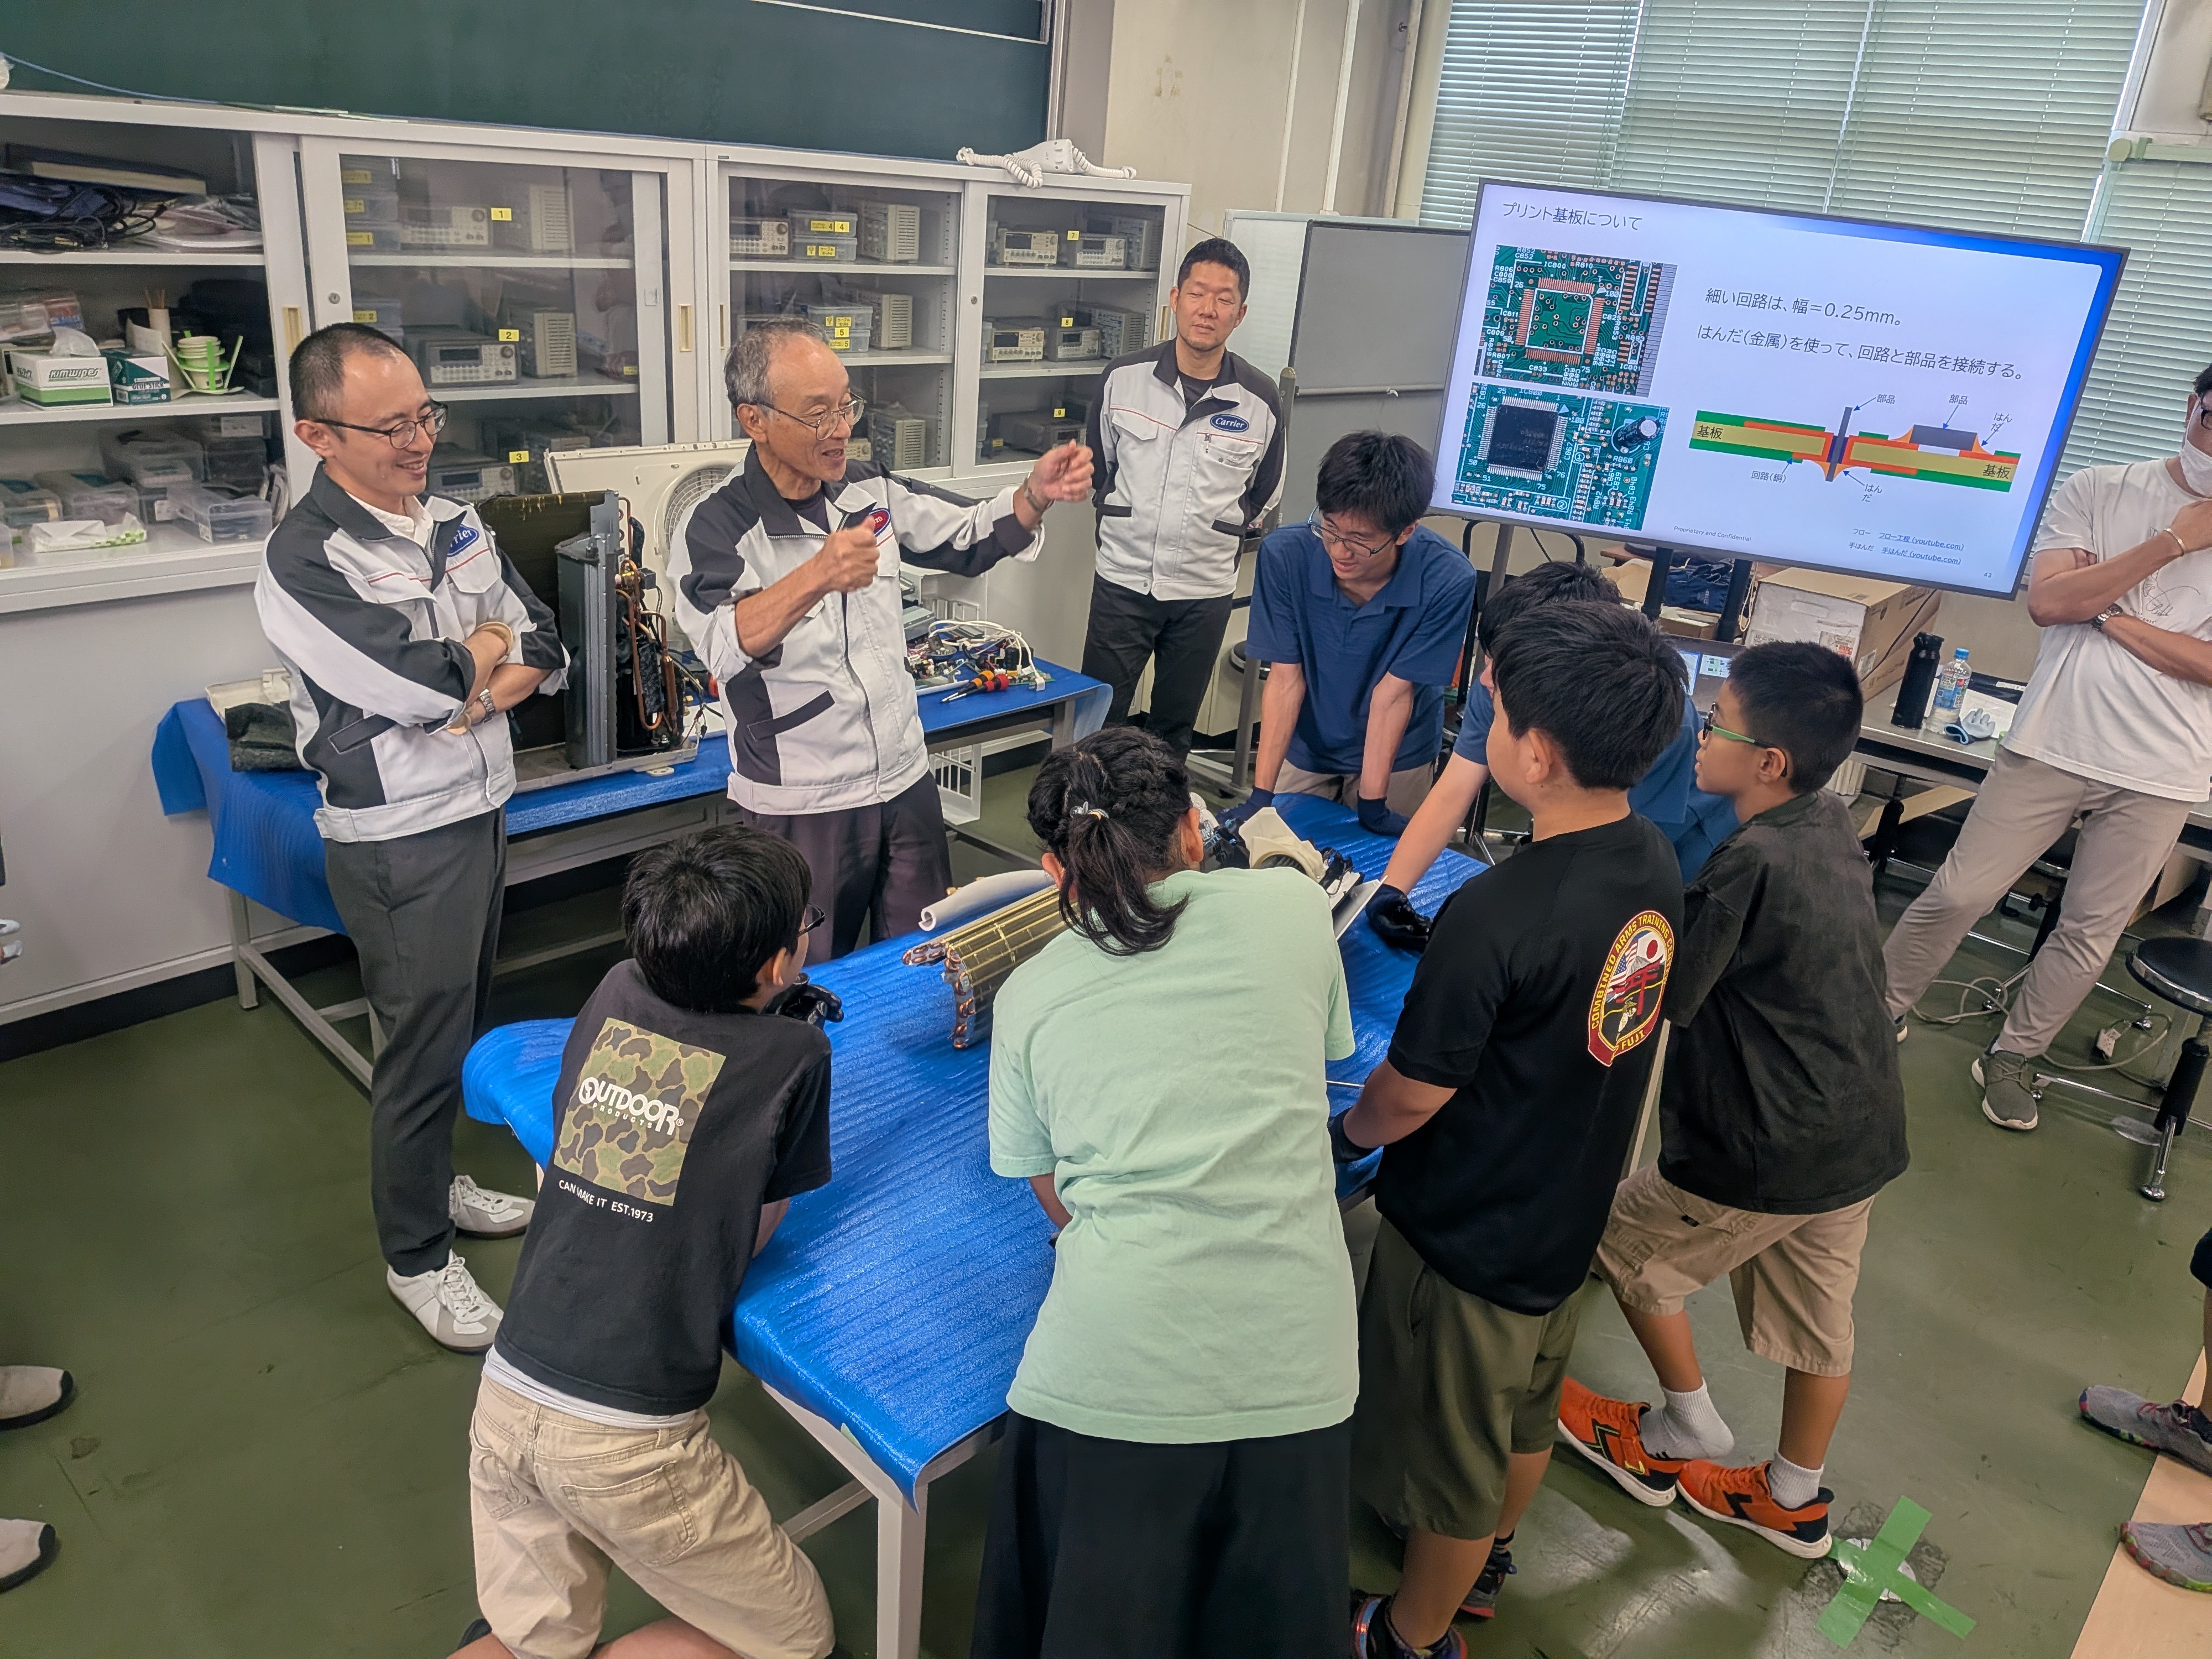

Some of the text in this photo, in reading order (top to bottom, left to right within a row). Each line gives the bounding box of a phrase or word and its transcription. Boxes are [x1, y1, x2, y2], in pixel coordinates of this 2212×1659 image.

[499, 210, 503, 218] 1
[1503, 202, 1642, 231] プリント基板について
[1877, 394, 1895, 404] 部品
[1949, 394, 1968, 405] 部品
[1215, 418, 1244, 428] Carrier
[1994, 413, 2012, 423] はん
[1697, 425, 1724, 440] 基板
[1564, 442, 1573, 460] C867
[1983, 464, 2011, 479] 基板
[1865, 484, 1882, 493] はん
[1862, 494, 1872, 502] だ
[1674, 526, 1704, 535] Proprietary
[1717, 533, 1751, 541] Confidential
[1912, 537, 1964, 551] (youtube.com)
[1910, 551, 1961, 565] (youtube.com)
[1592, 956, 1616, 1030] COMBINED
[1614, 921, 1637, 953] ARMS
[1638, 914, 1670, 939] TRAINING
[1621, 1030, 1645, 1050] FUJI
[578, 1077, 680, 1136] OUTDOOR
[592, 1102, 653, 1129] PRODUCTS
[559, 1180, 653, 1223] CAN MAKE IT EST.1973
